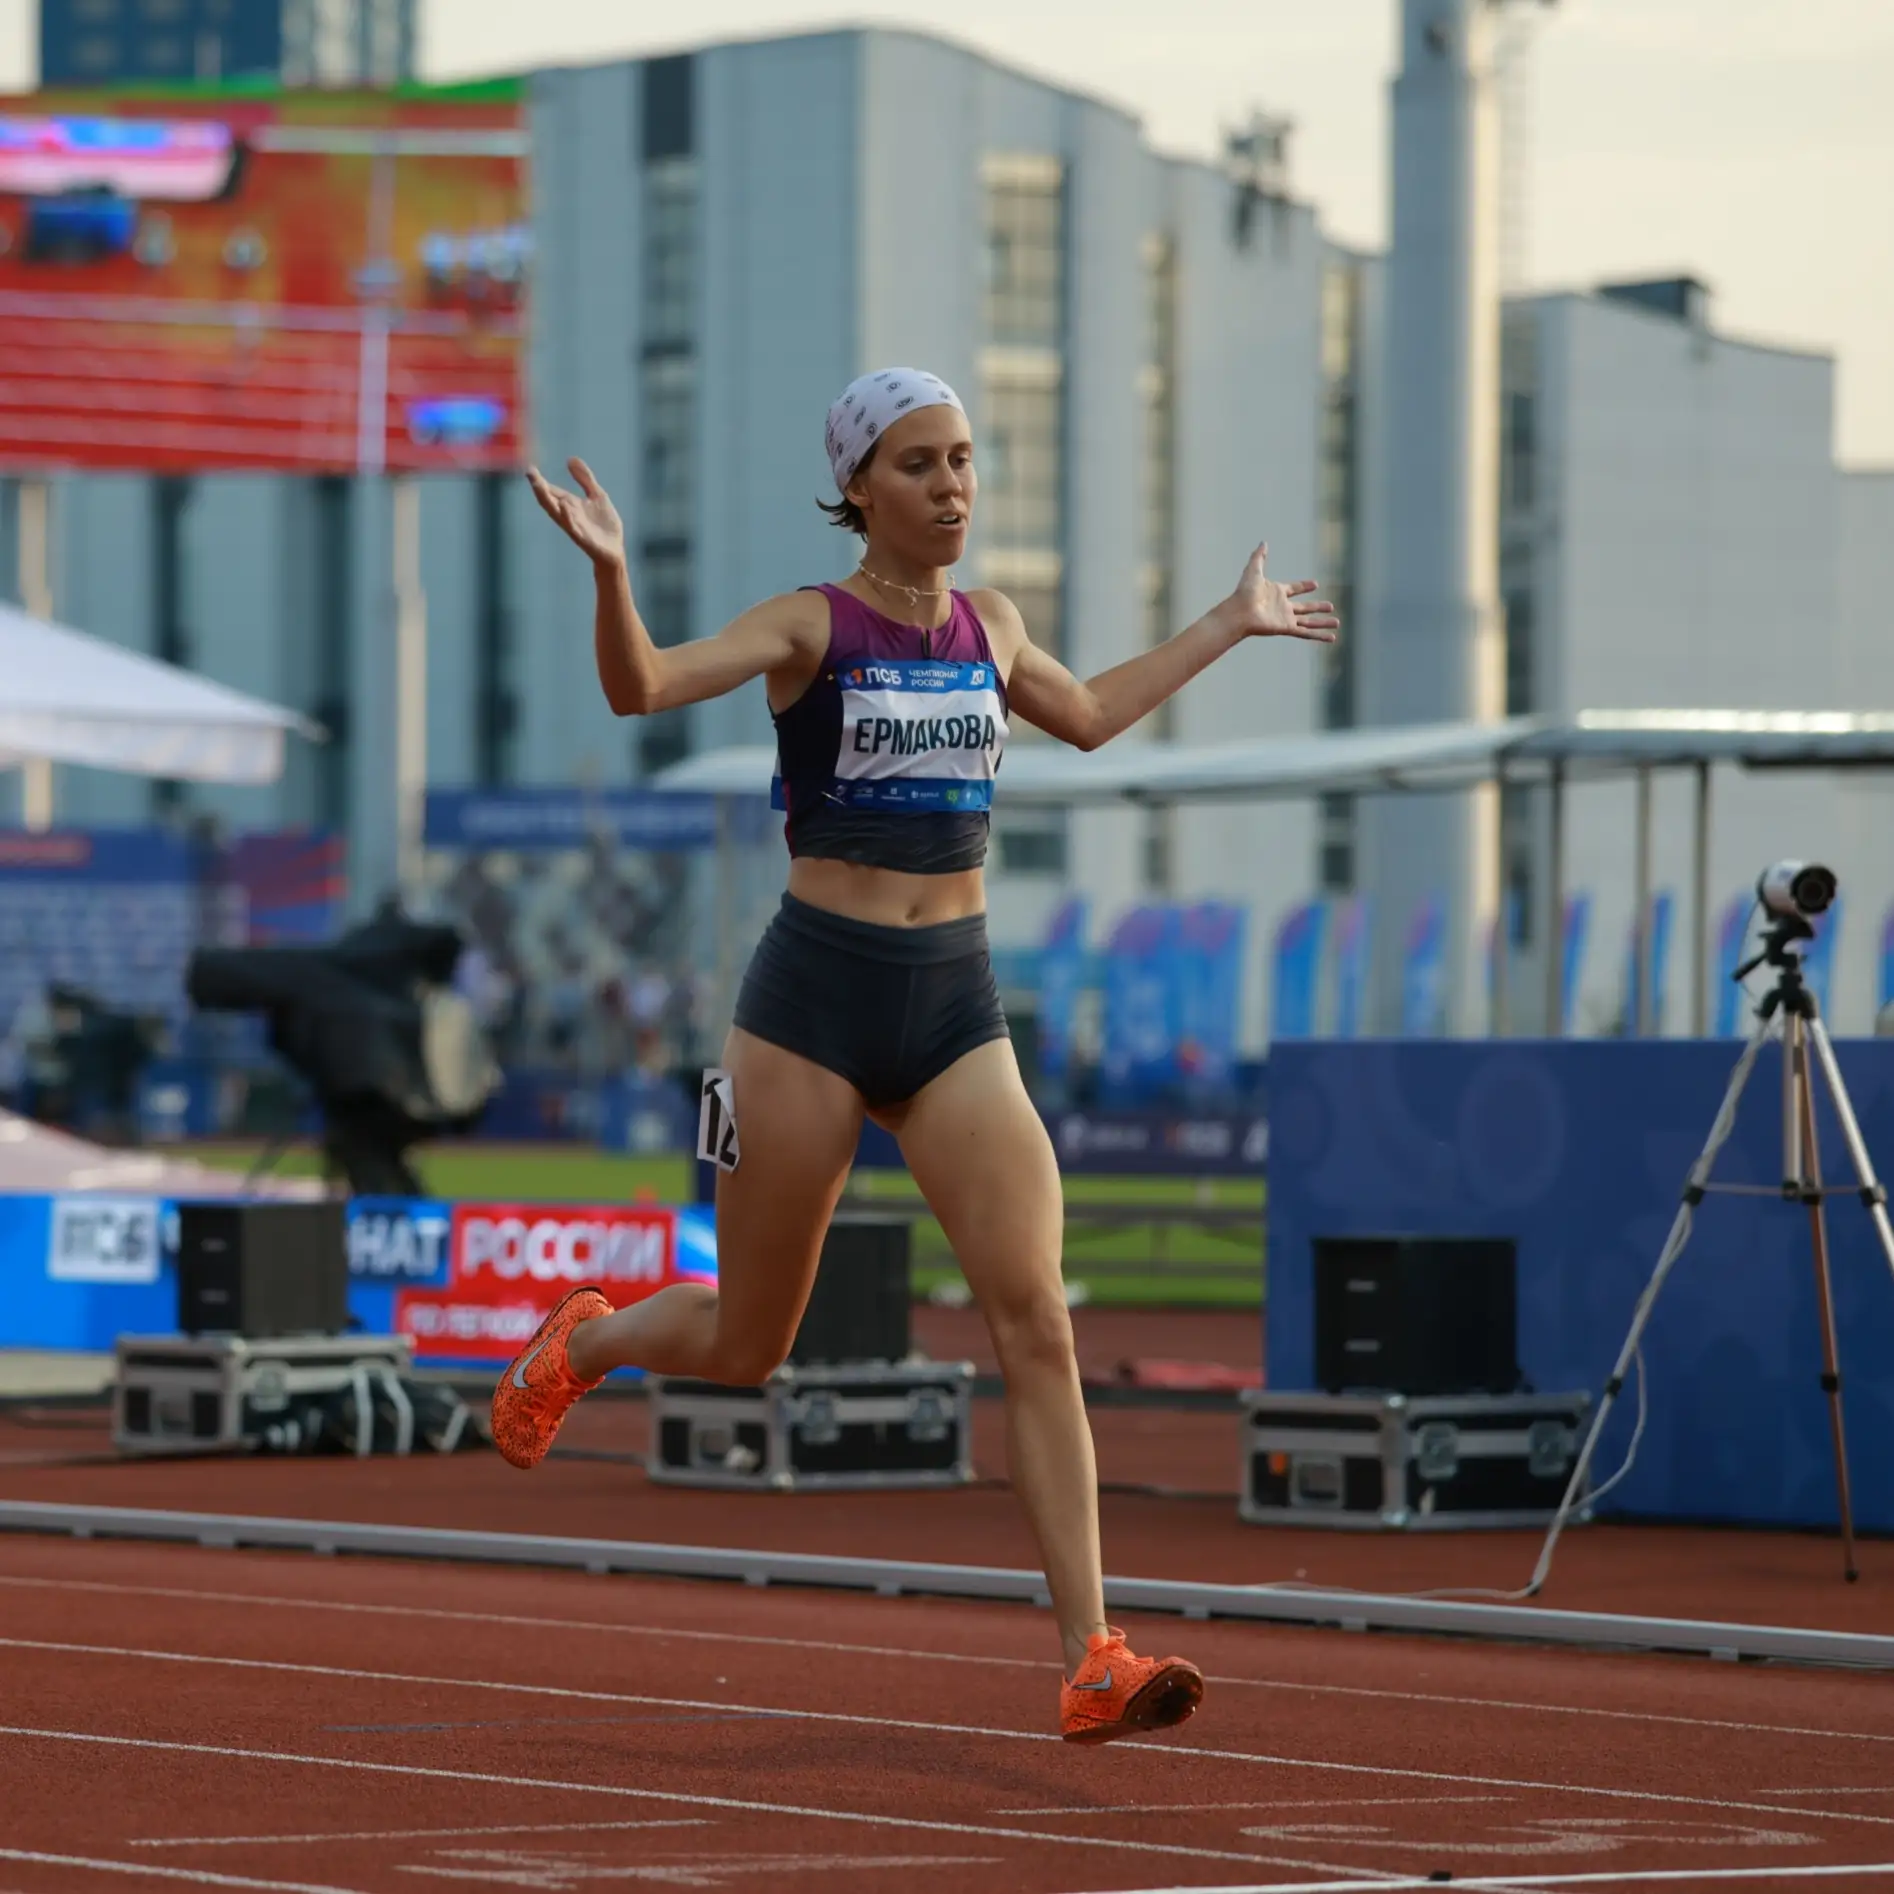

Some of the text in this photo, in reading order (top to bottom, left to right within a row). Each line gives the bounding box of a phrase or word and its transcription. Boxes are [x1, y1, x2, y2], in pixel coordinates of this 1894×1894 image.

[865, 667, 902, 685] ПСБ
[908, 668, 958, 679] ЧЕМПИОНАТ
[911, 678, 944, 688] РОССИИ
[854, 714, 995, 755] ЕРМАКОВА
[461, 1216, 666, 1282] РОССИИ
